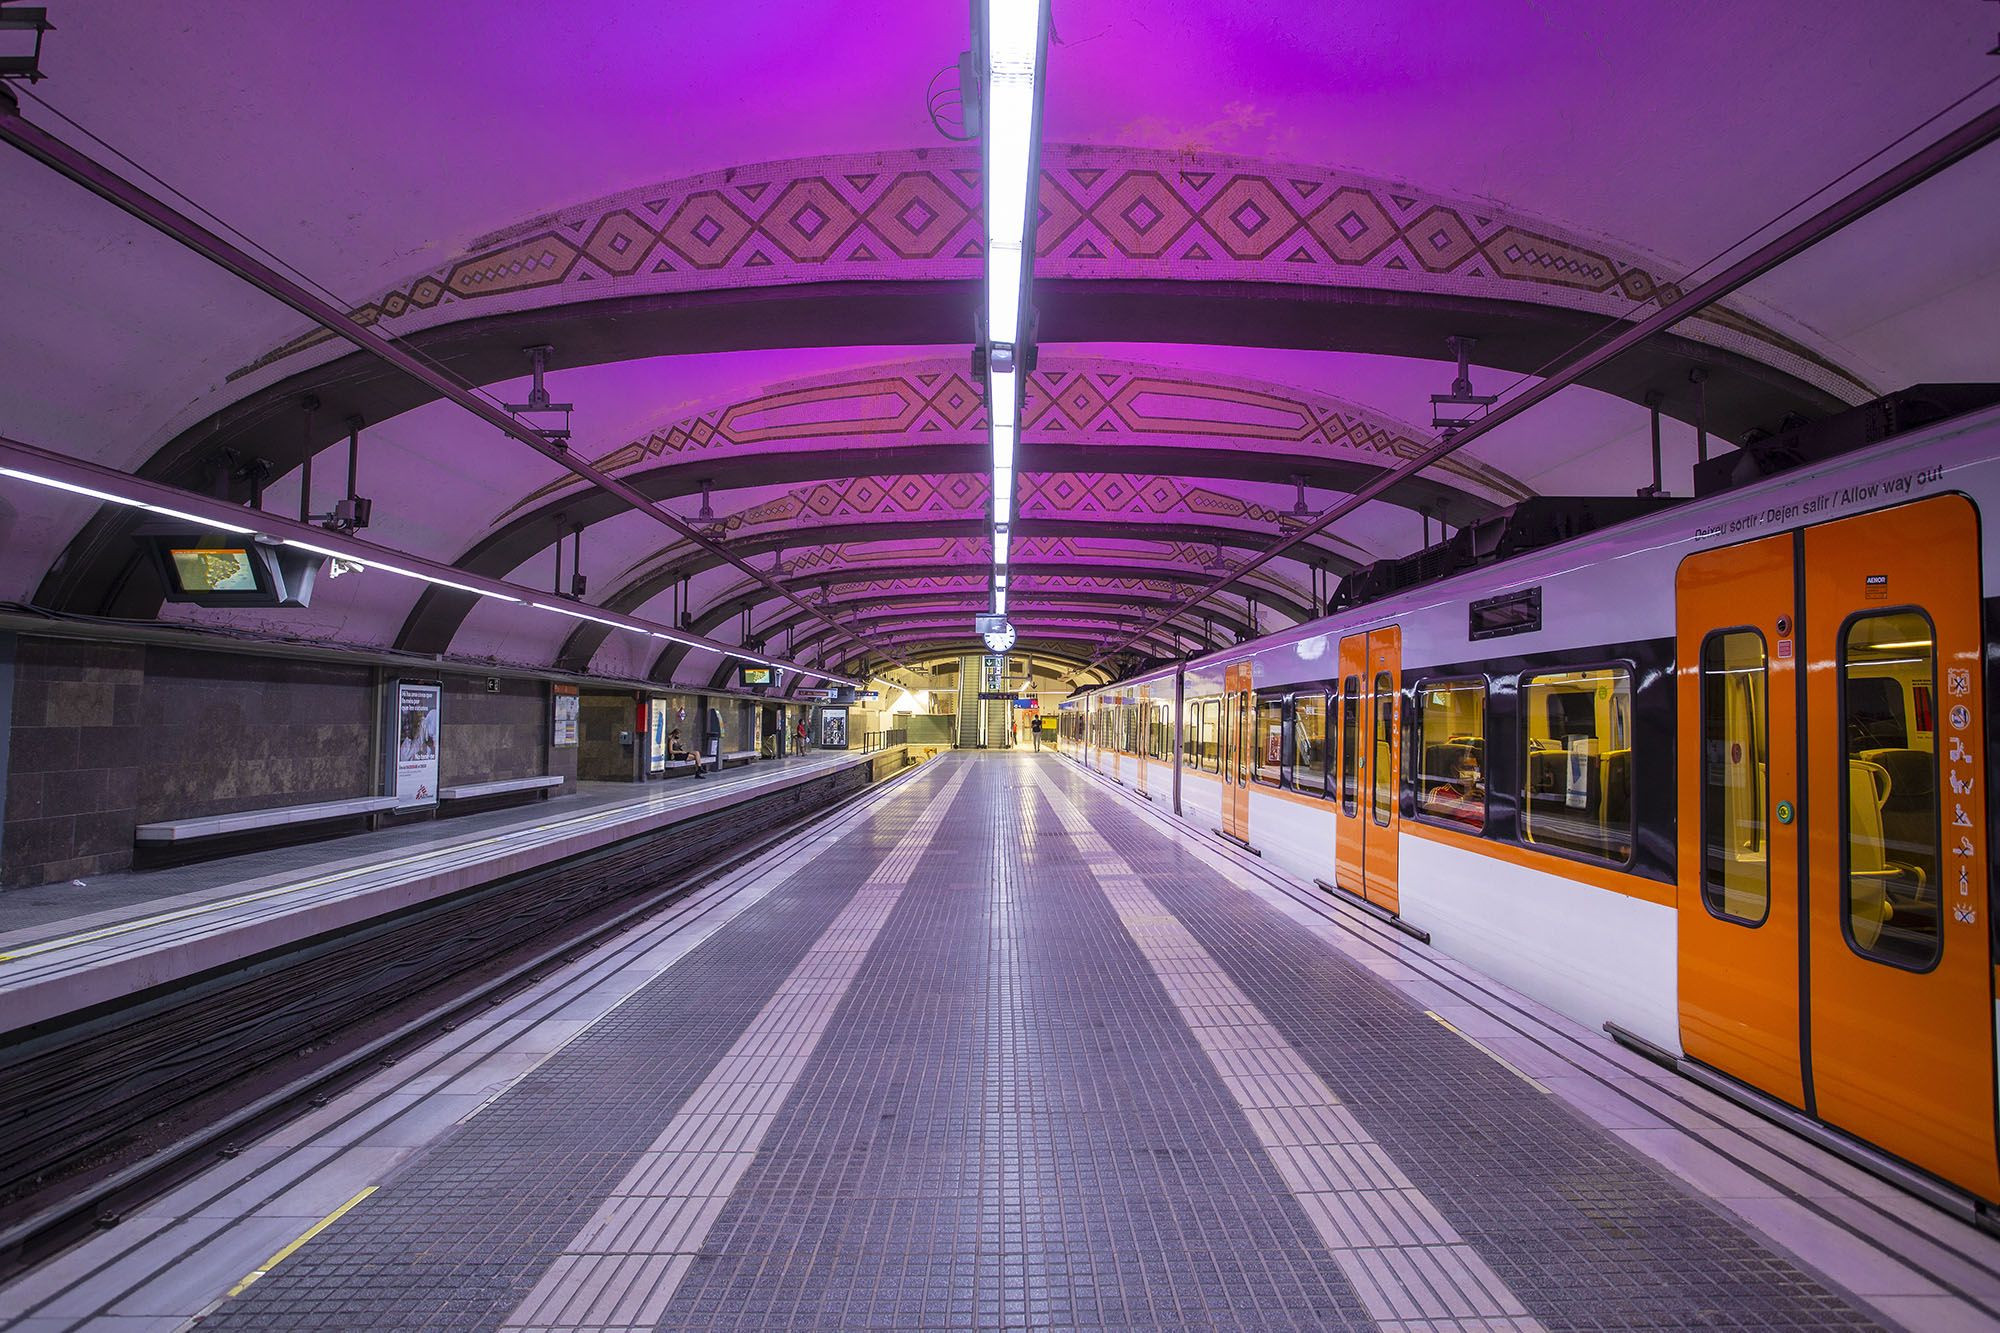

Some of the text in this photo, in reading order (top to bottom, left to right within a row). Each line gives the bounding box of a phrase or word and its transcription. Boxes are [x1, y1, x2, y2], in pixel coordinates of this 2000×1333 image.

[1694, 523, 1727, 542] Deixeu
[1729, 515, 1758, 533] sortir
[1767, 505, 1799, 524] Dejen
[1802, 496, 1830, 514] salir
[1832, 491, 1838, 506] /
[1841, 483, 1879, 505] Allow
[1883, 475, 1912, 494] way
[1917, 464, 1944, 485] out
[1867, 576, 1886, 584] AENOR
